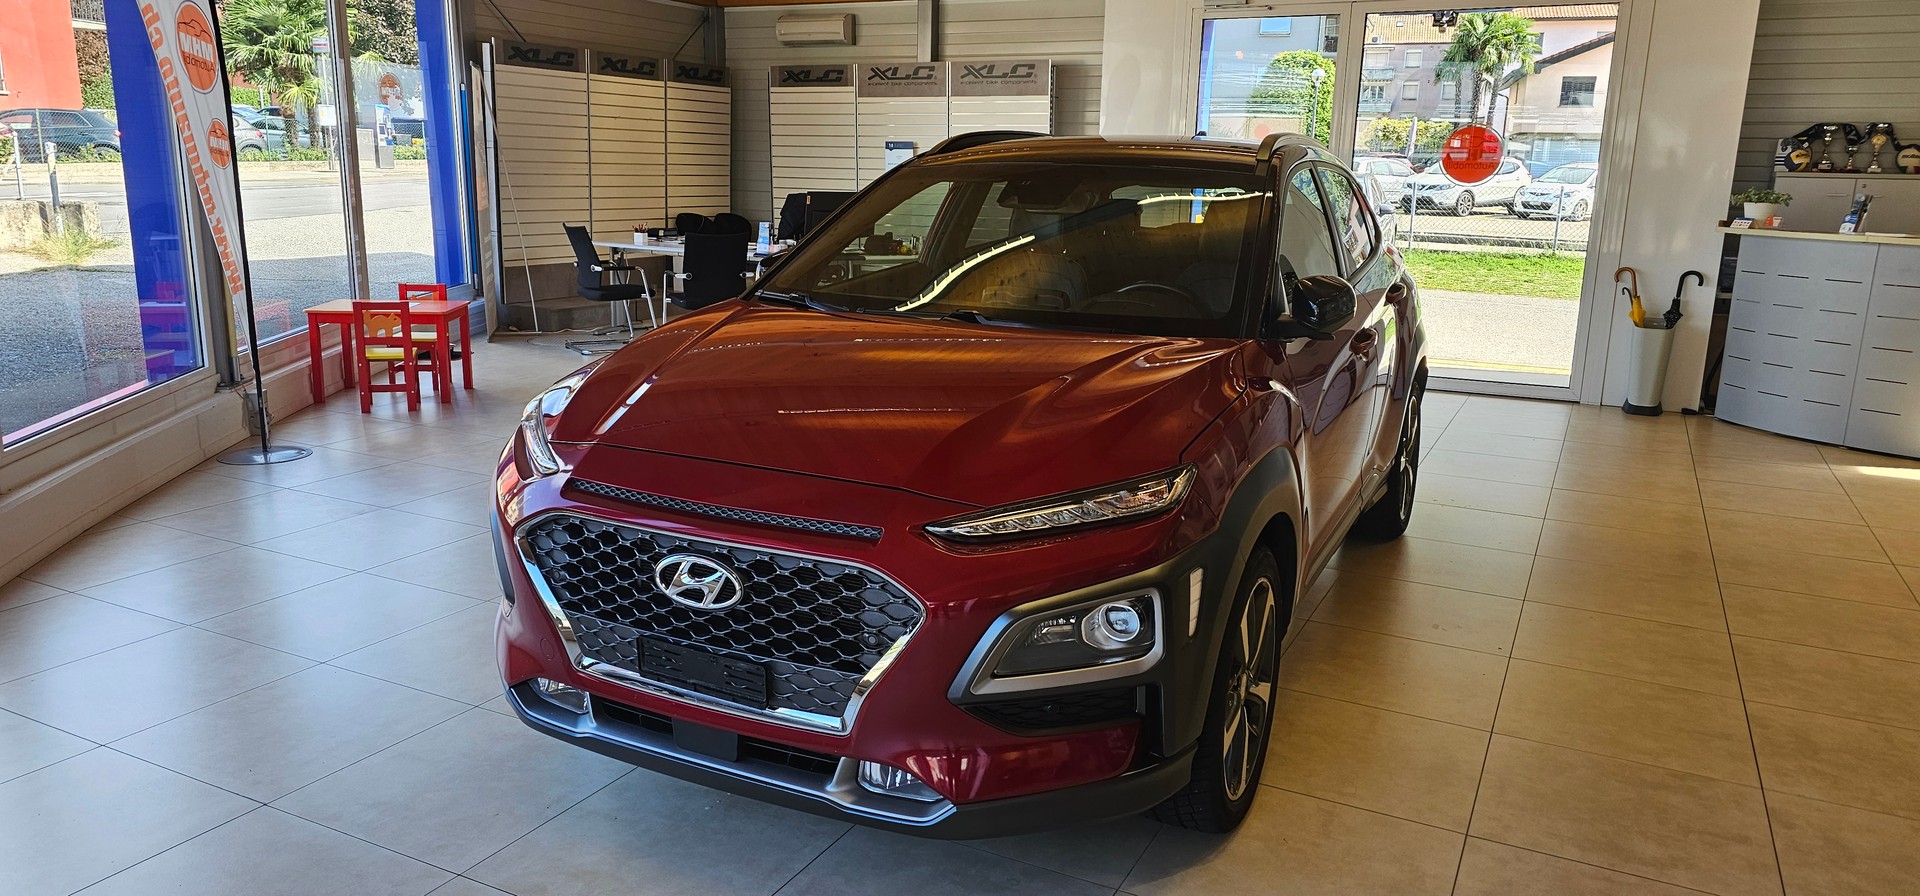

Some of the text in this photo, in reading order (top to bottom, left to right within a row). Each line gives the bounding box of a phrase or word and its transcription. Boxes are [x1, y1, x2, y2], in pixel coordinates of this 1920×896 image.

[507, 46, 575, 67] XLC
[600, 56, 657, 76] XLC
[676, 65, 724, 82] XLC
[867, 65, 936, 80] XLC
[960, 63, 1036, 79] XLC
[782, 69, 844, 83] XLC
